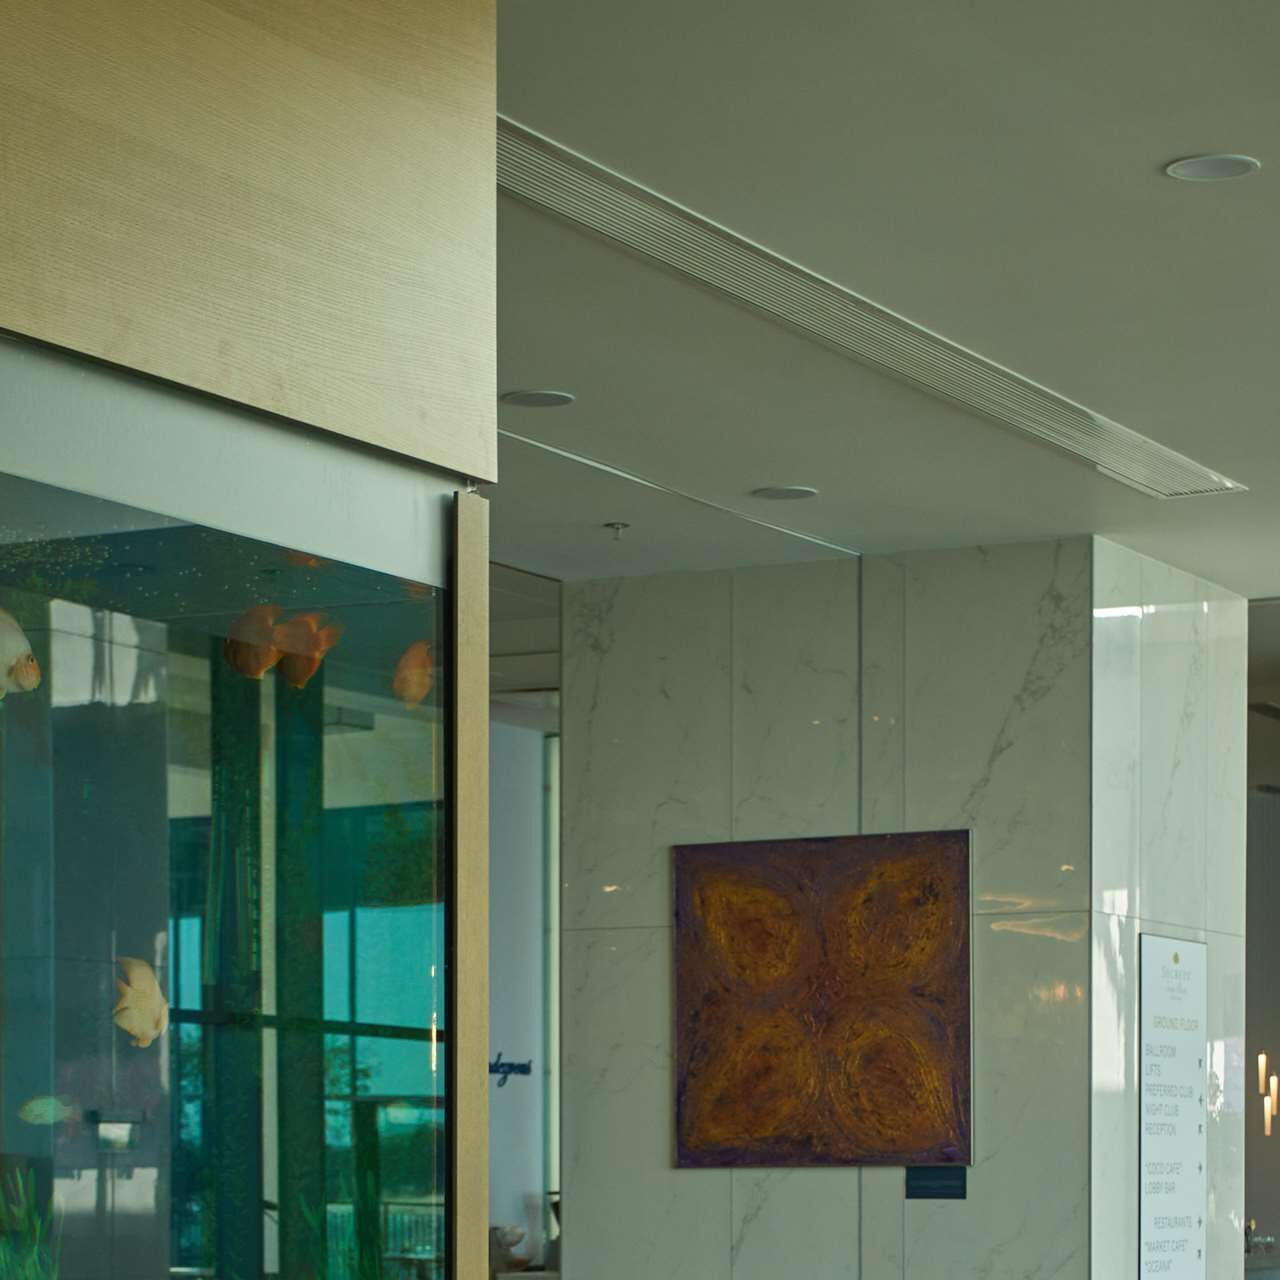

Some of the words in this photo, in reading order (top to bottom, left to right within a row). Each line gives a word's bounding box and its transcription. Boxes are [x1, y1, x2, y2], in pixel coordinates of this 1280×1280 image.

[1153, 1016, 1178, 1030] GROUND
[1180, 1017, 1199, 1032] FLOOR
[1145, 1043, 1176, 1058] BALLROOM
[1145, 1063, 1161, 1077] LIFTS
[1145, 1082, 1177, 1097] PREFERRED
[1179, 1085, 1193, 1099] CLUB
[1145, 1103, 1163, 1116] NIGHT
[1165, 1103, 1179, 1117] CLUB
[1145, 1121, 1176, 1136] RECEPTION
[1145, 1181, 1162, 1195] LOBBY
[1164, 1181, 1176, 1195] BAR
